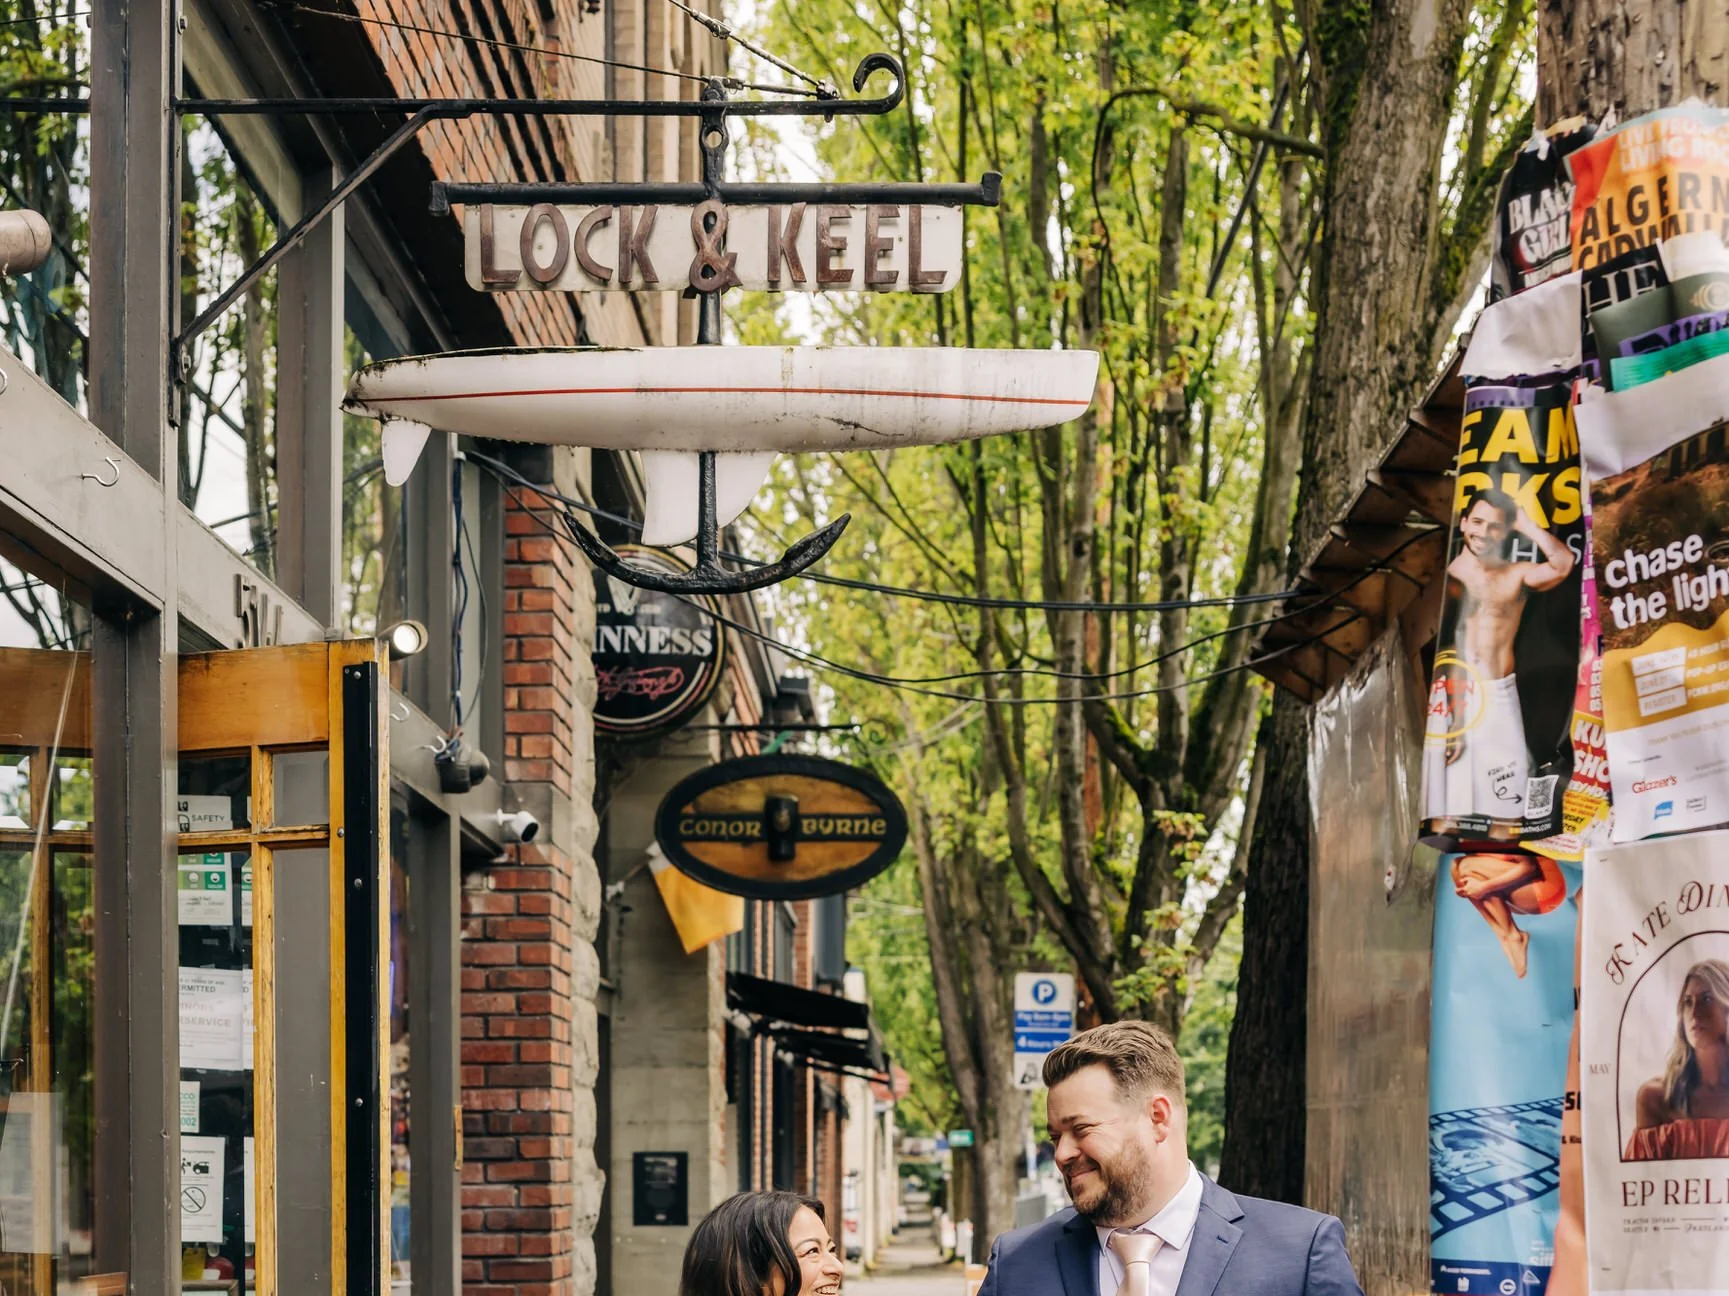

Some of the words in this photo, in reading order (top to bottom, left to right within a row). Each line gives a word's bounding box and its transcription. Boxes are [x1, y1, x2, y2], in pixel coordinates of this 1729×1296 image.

[479, 202, 659, 285] LOCK
[690, 200, 742, 292] &
[768, 202, 948, 285] KEEL
[1604, 534, 1704, 589] chase
[1609, 591, 1668, 629] the
[1672, 564, 1729, 612] ligh
[191, 814, 225, 823] SAFETY
[1606, 900, 1671, 985] KATE
[1621, 1179, 1655, 1208] EP
[1664, 1178, 1729, 1207] REL
